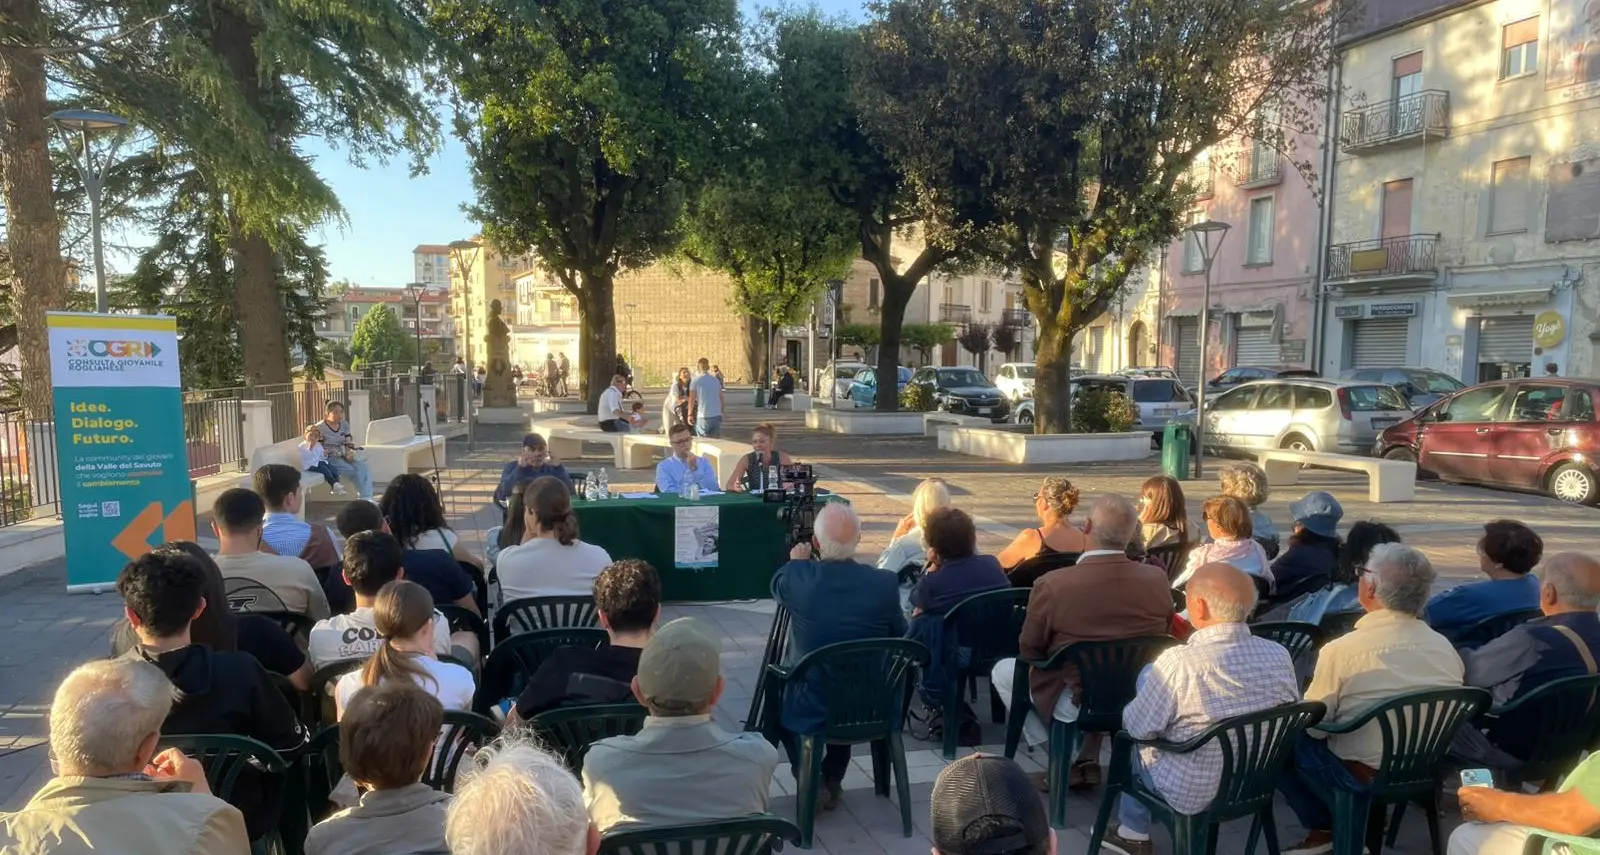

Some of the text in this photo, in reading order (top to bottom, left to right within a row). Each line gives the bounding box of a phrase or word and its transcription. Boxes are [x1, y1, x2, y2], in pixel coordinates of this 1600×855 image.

[69, 359, 163, 367] CONSULTA GIOVANILE
[70, 402, 111, 413] Idee.
[71, 417, 139, 431] Dialogo.
[73, 433, 134, 445] Futuro.
[75, 463, 96, 471] della
[134, 461, 162, 469] Savuto
